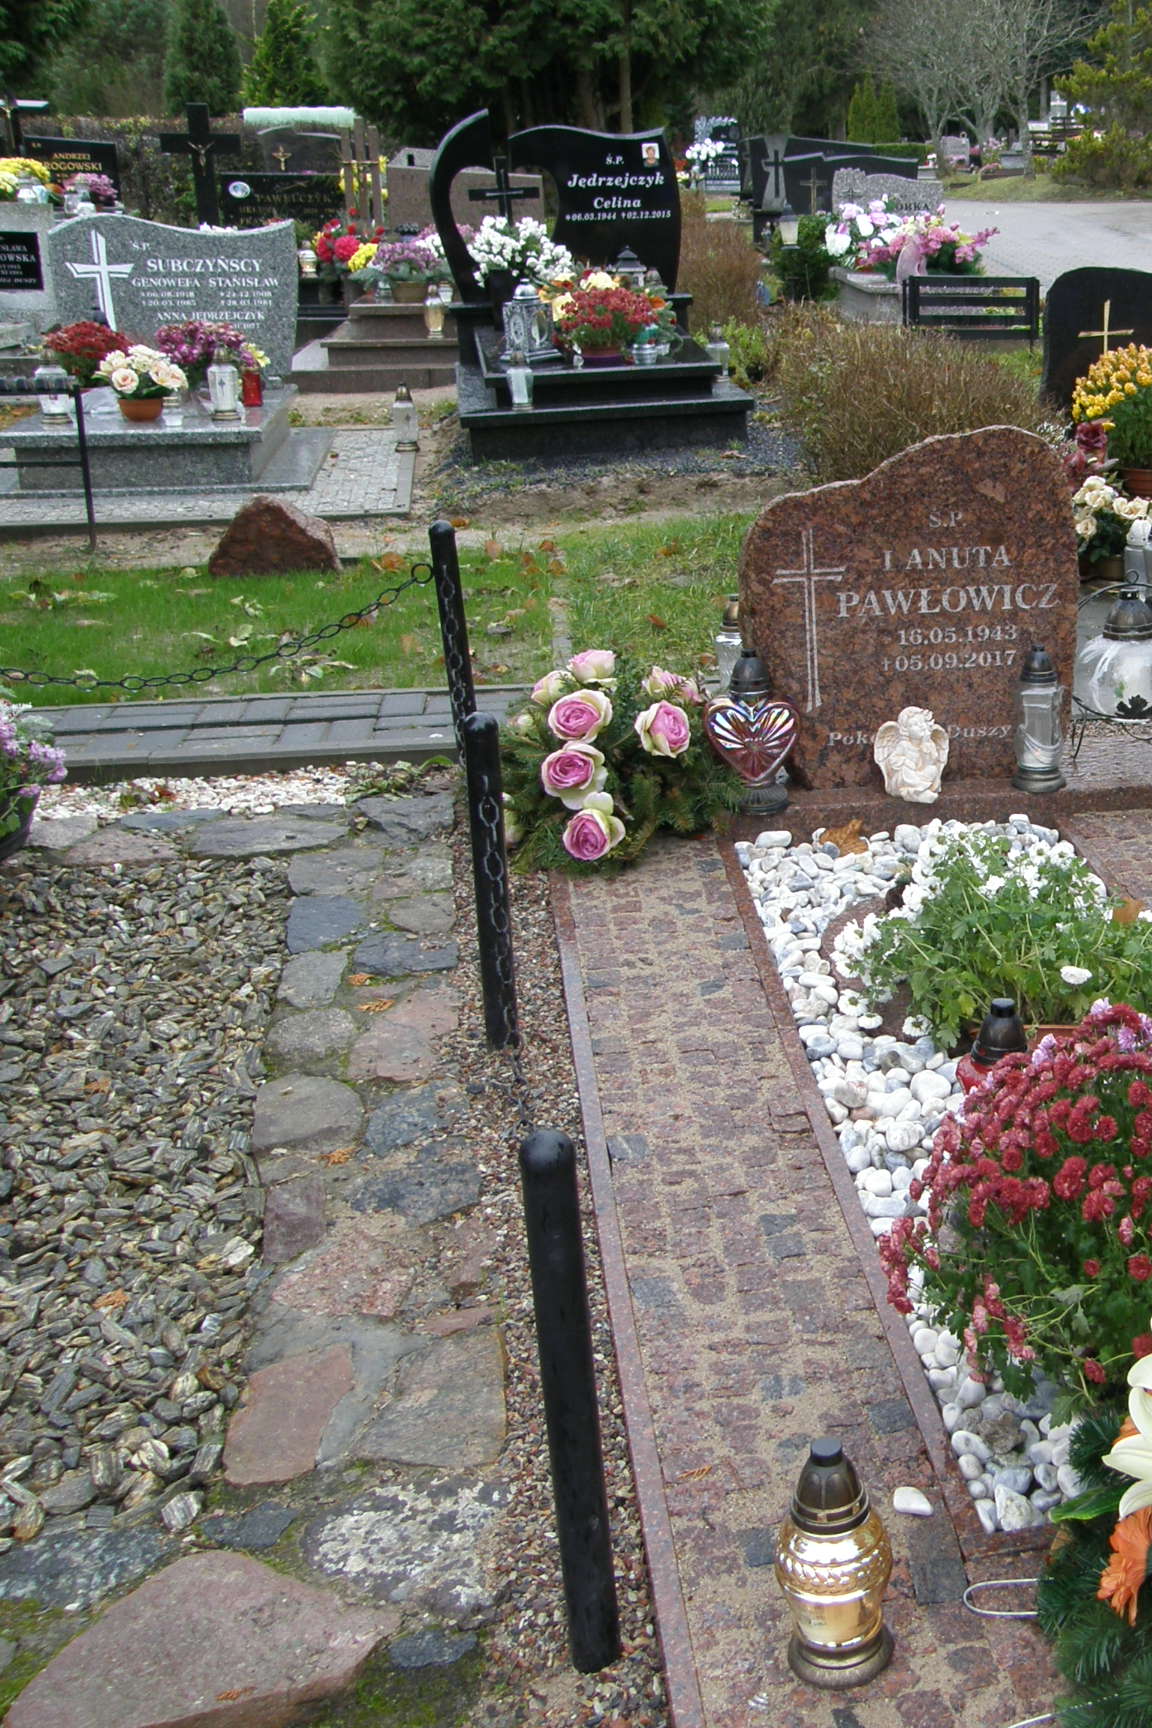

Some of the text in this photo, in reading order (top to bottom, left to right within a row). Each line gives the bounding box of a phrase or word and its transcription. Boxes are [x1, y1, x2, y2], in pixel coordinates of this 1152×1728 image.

[567, 172, 665, 189] Jędrzejczyk
[593, 197, 642, 209] Celina
[0, 253, 37, 262] OWSKA
[146, 256, 263, 272] SUBCZYŃSCY
[131, 278, 201, 288] GENOWEFA
[836, 583, 1062, 618] PAWŁOWICZ
